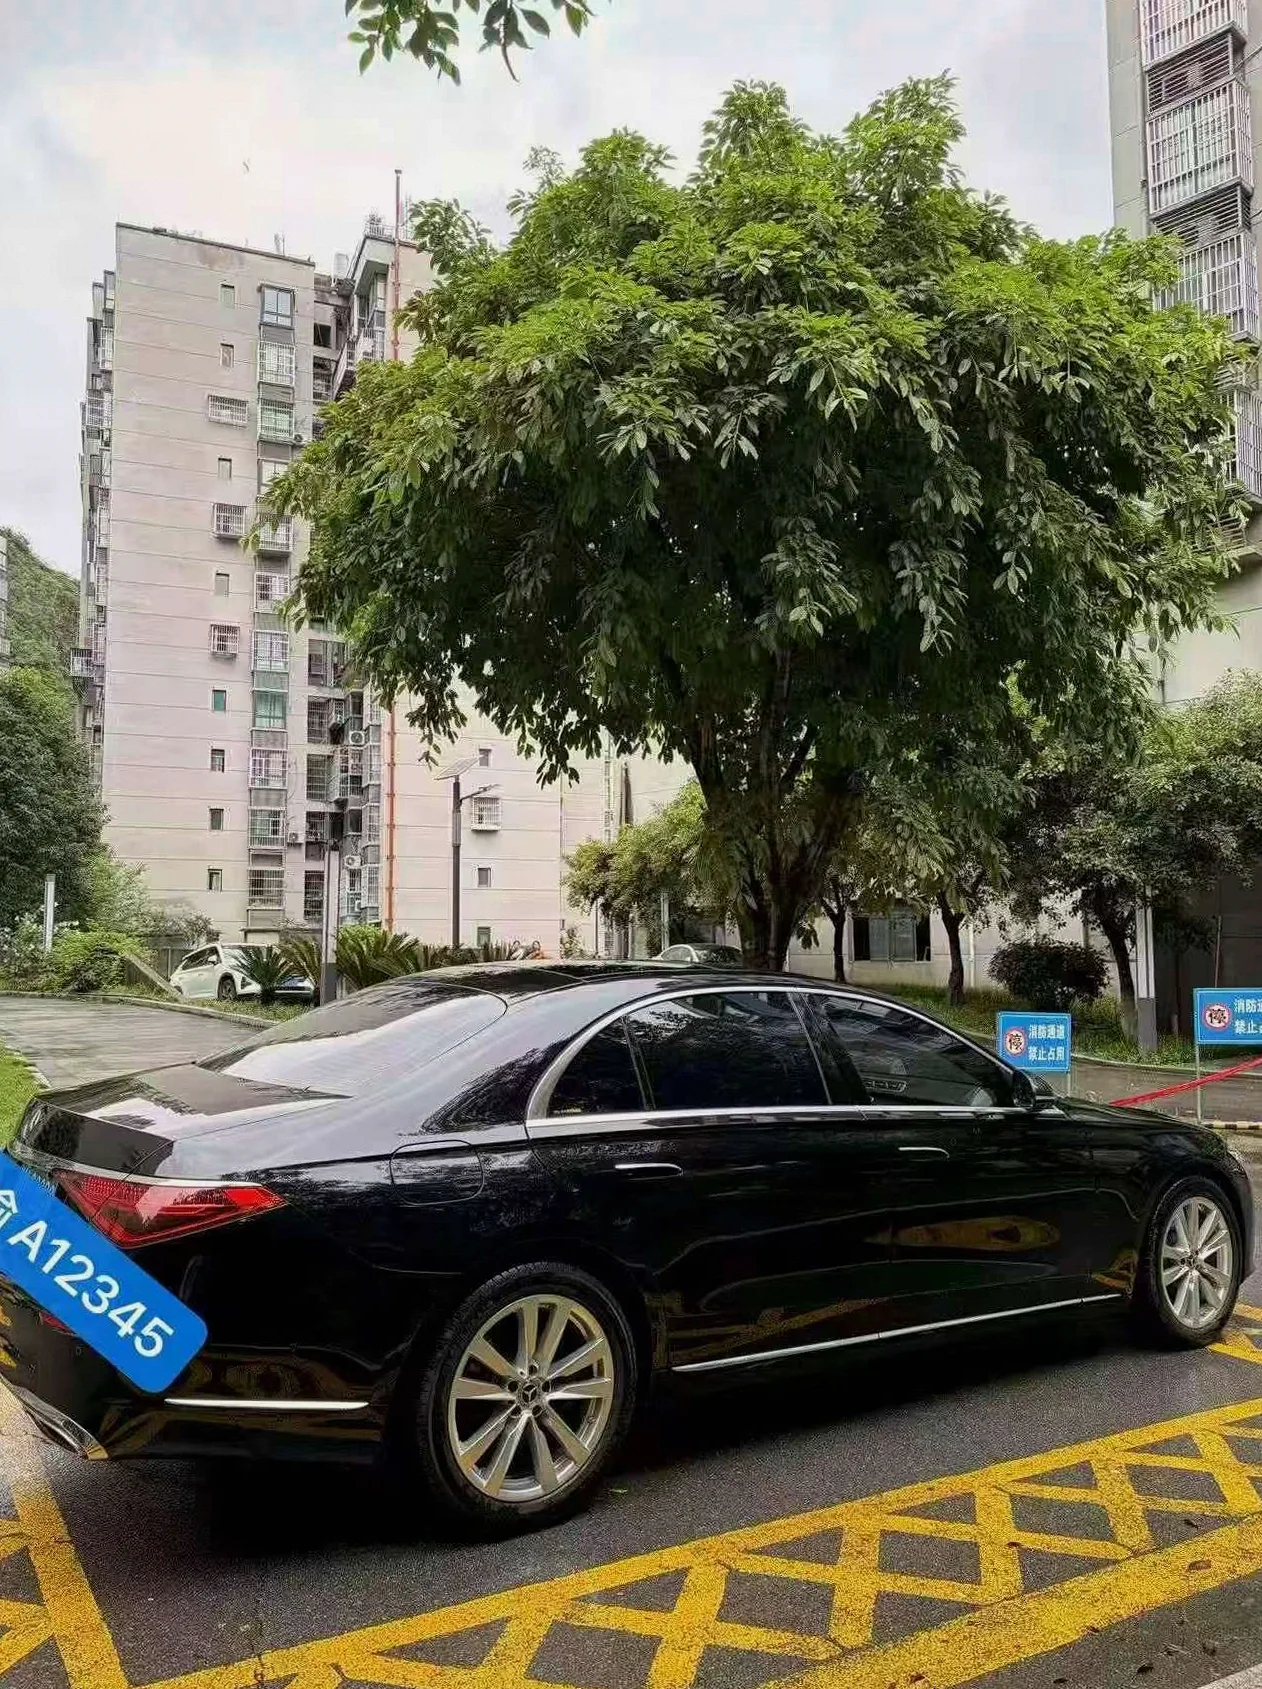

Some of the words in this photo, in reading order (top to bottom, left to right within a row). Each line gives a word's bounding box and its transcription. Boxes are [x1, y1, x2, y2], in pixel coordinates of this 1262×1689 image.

[1028, 1023, 1065, 1040] 消防通道
[1027, 1045, 1065, 1061] 禁止占用
